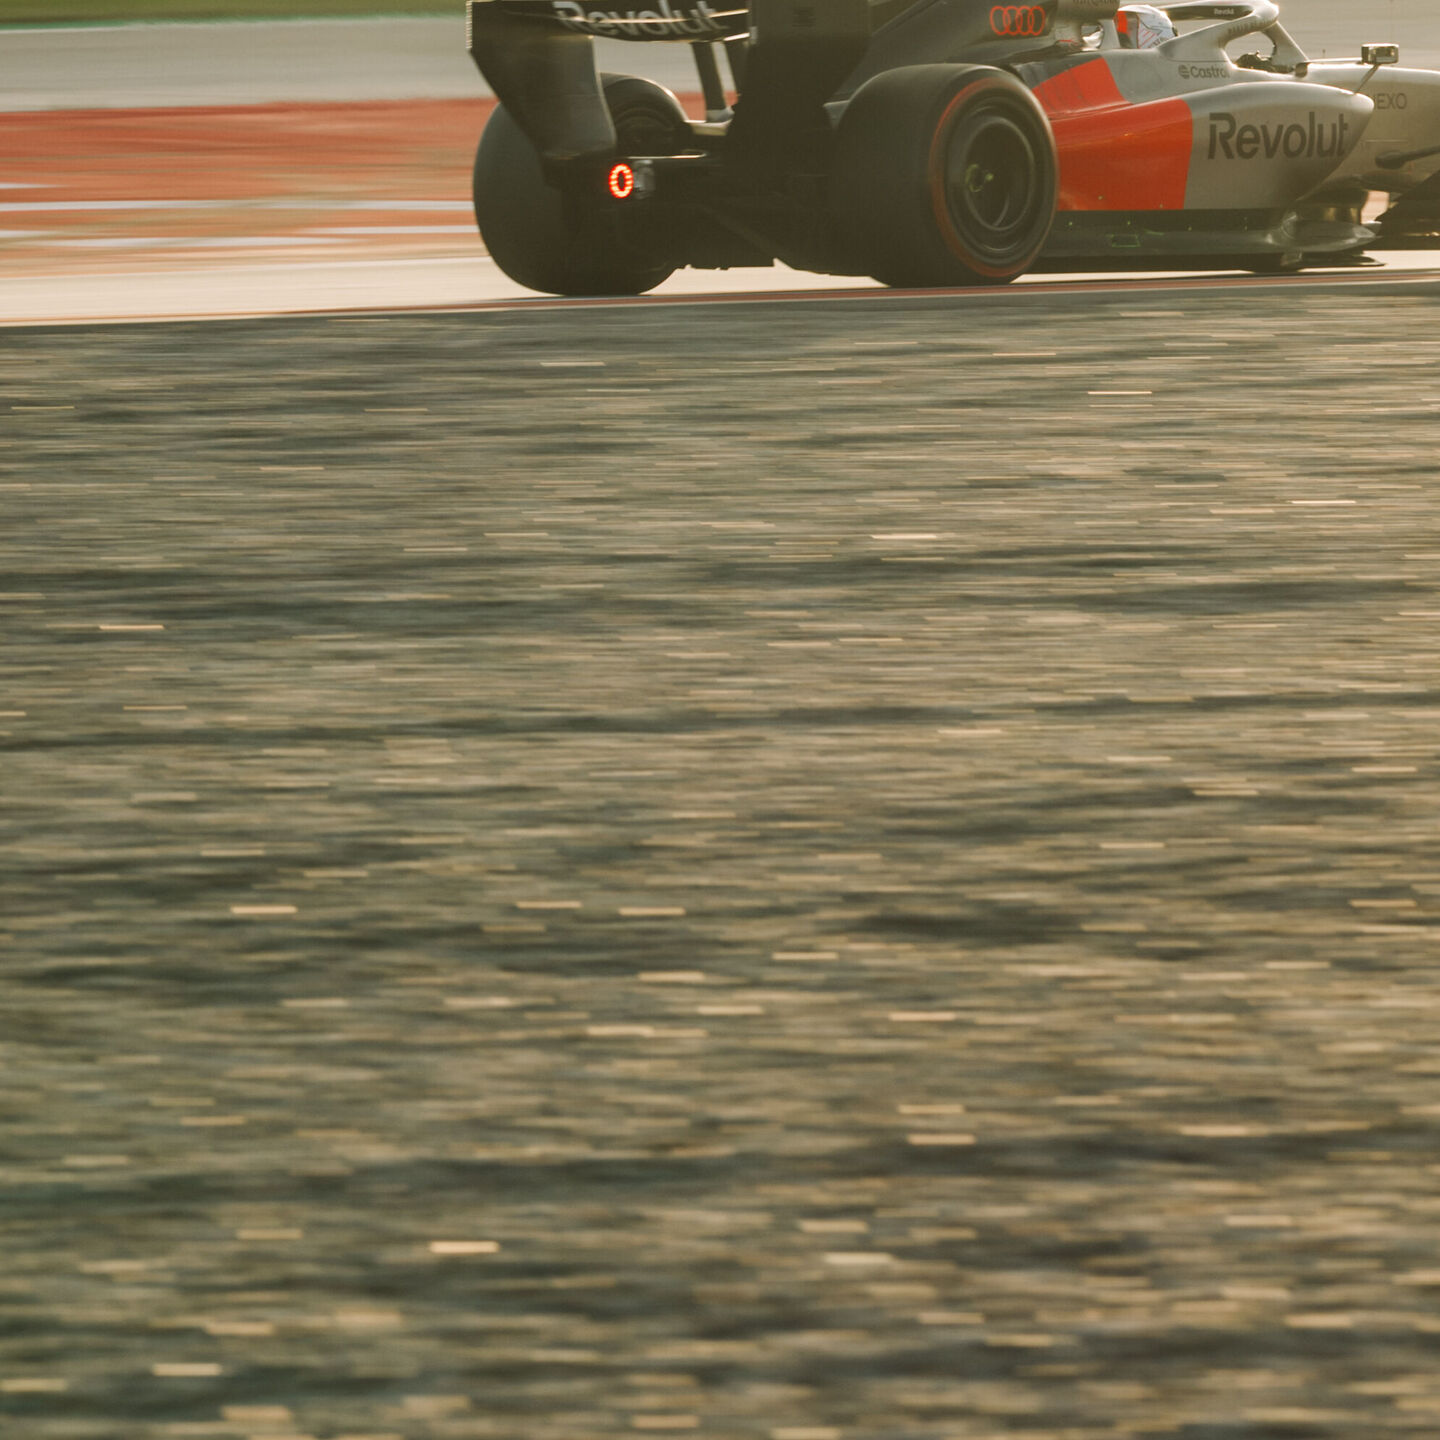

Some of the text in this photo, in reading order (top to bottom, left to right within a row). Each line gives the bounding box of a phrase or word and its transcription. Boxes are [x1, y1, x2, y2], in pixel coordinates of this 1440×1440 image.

[553, 0, 730, 36] Revolut
[1375, 92, 1408, 110] EXO
[1207, 111, 1349, 160] Revolut
